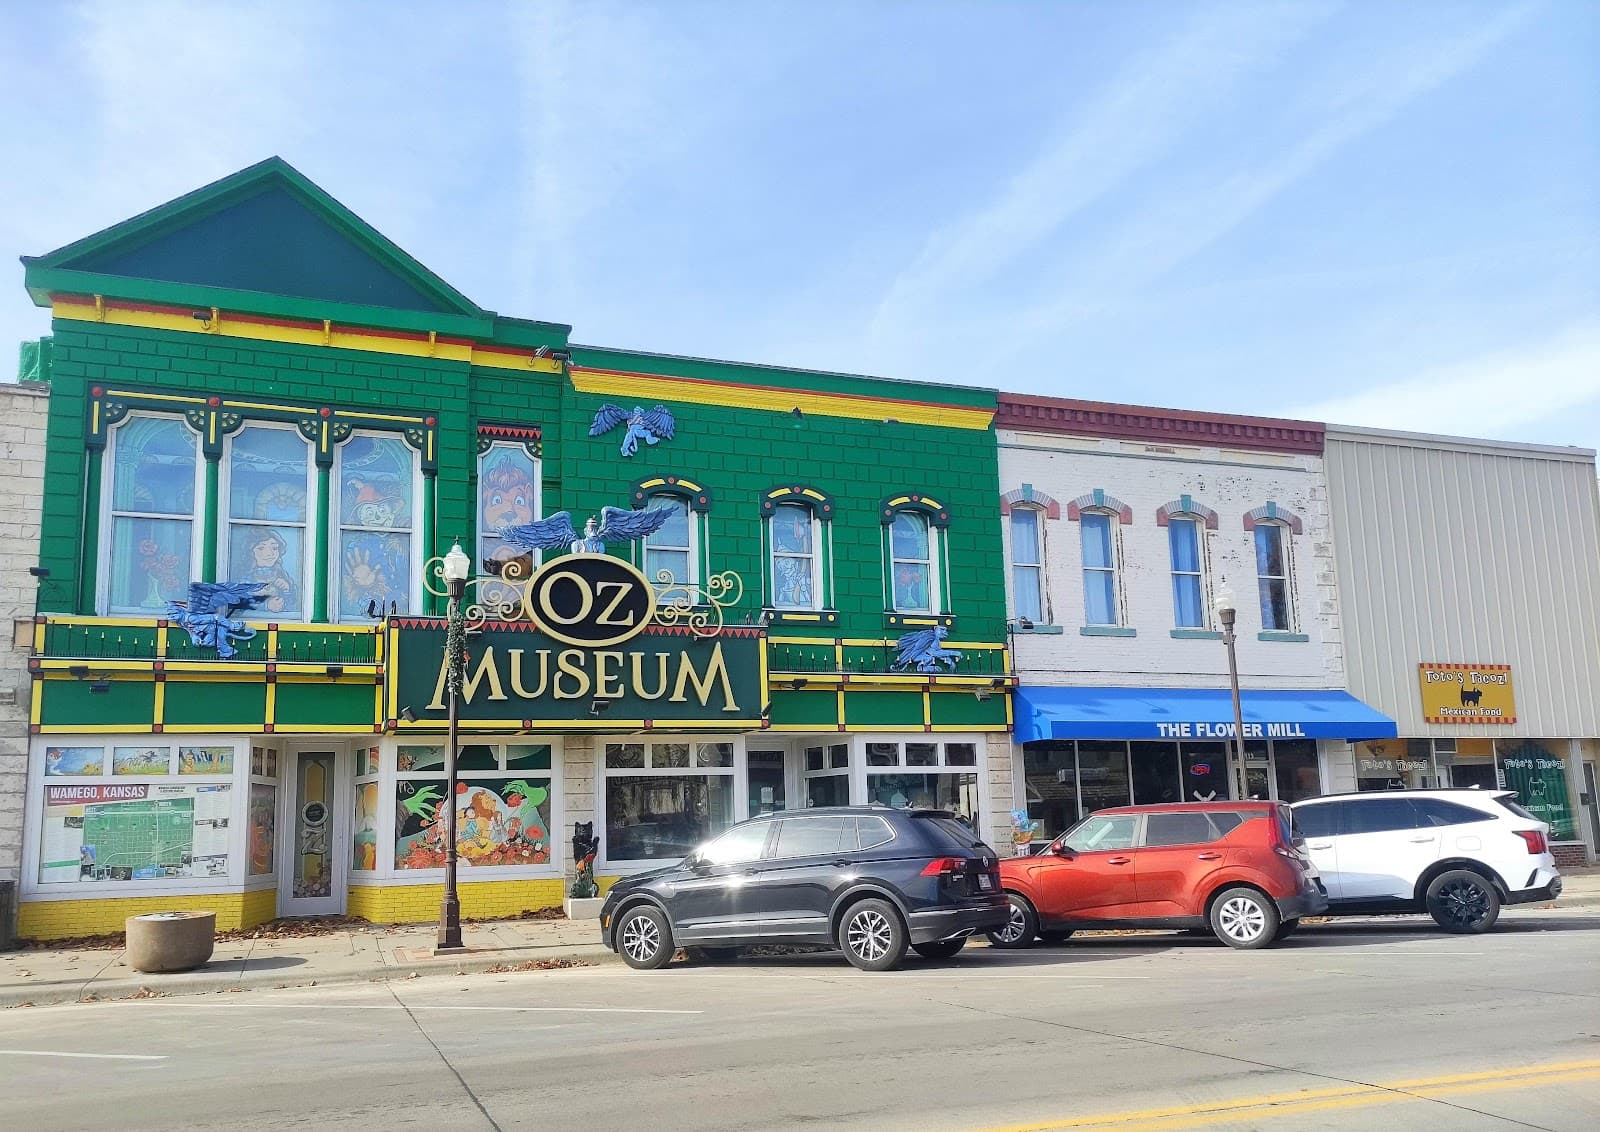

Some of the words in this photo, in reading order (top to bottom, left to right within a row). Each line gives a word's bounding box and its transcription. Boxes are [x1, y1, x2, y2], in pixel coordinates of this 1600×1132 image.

[424, 641, 741, 711] MUSEUM
[1425, 671, 1464, 683] Toto's
[1440, 707, 1477, 715] Mexican
[1480, 707, 1501, 715] Food
[1156, 723, 1191, 737] THE
[1195, 723, 1262, 737] FLOWER
[1267, 723, 1306, 737] MILL
[50, 786, 101, 800] WAMEGO,
[102, 785, 146, 799] KANSAS
